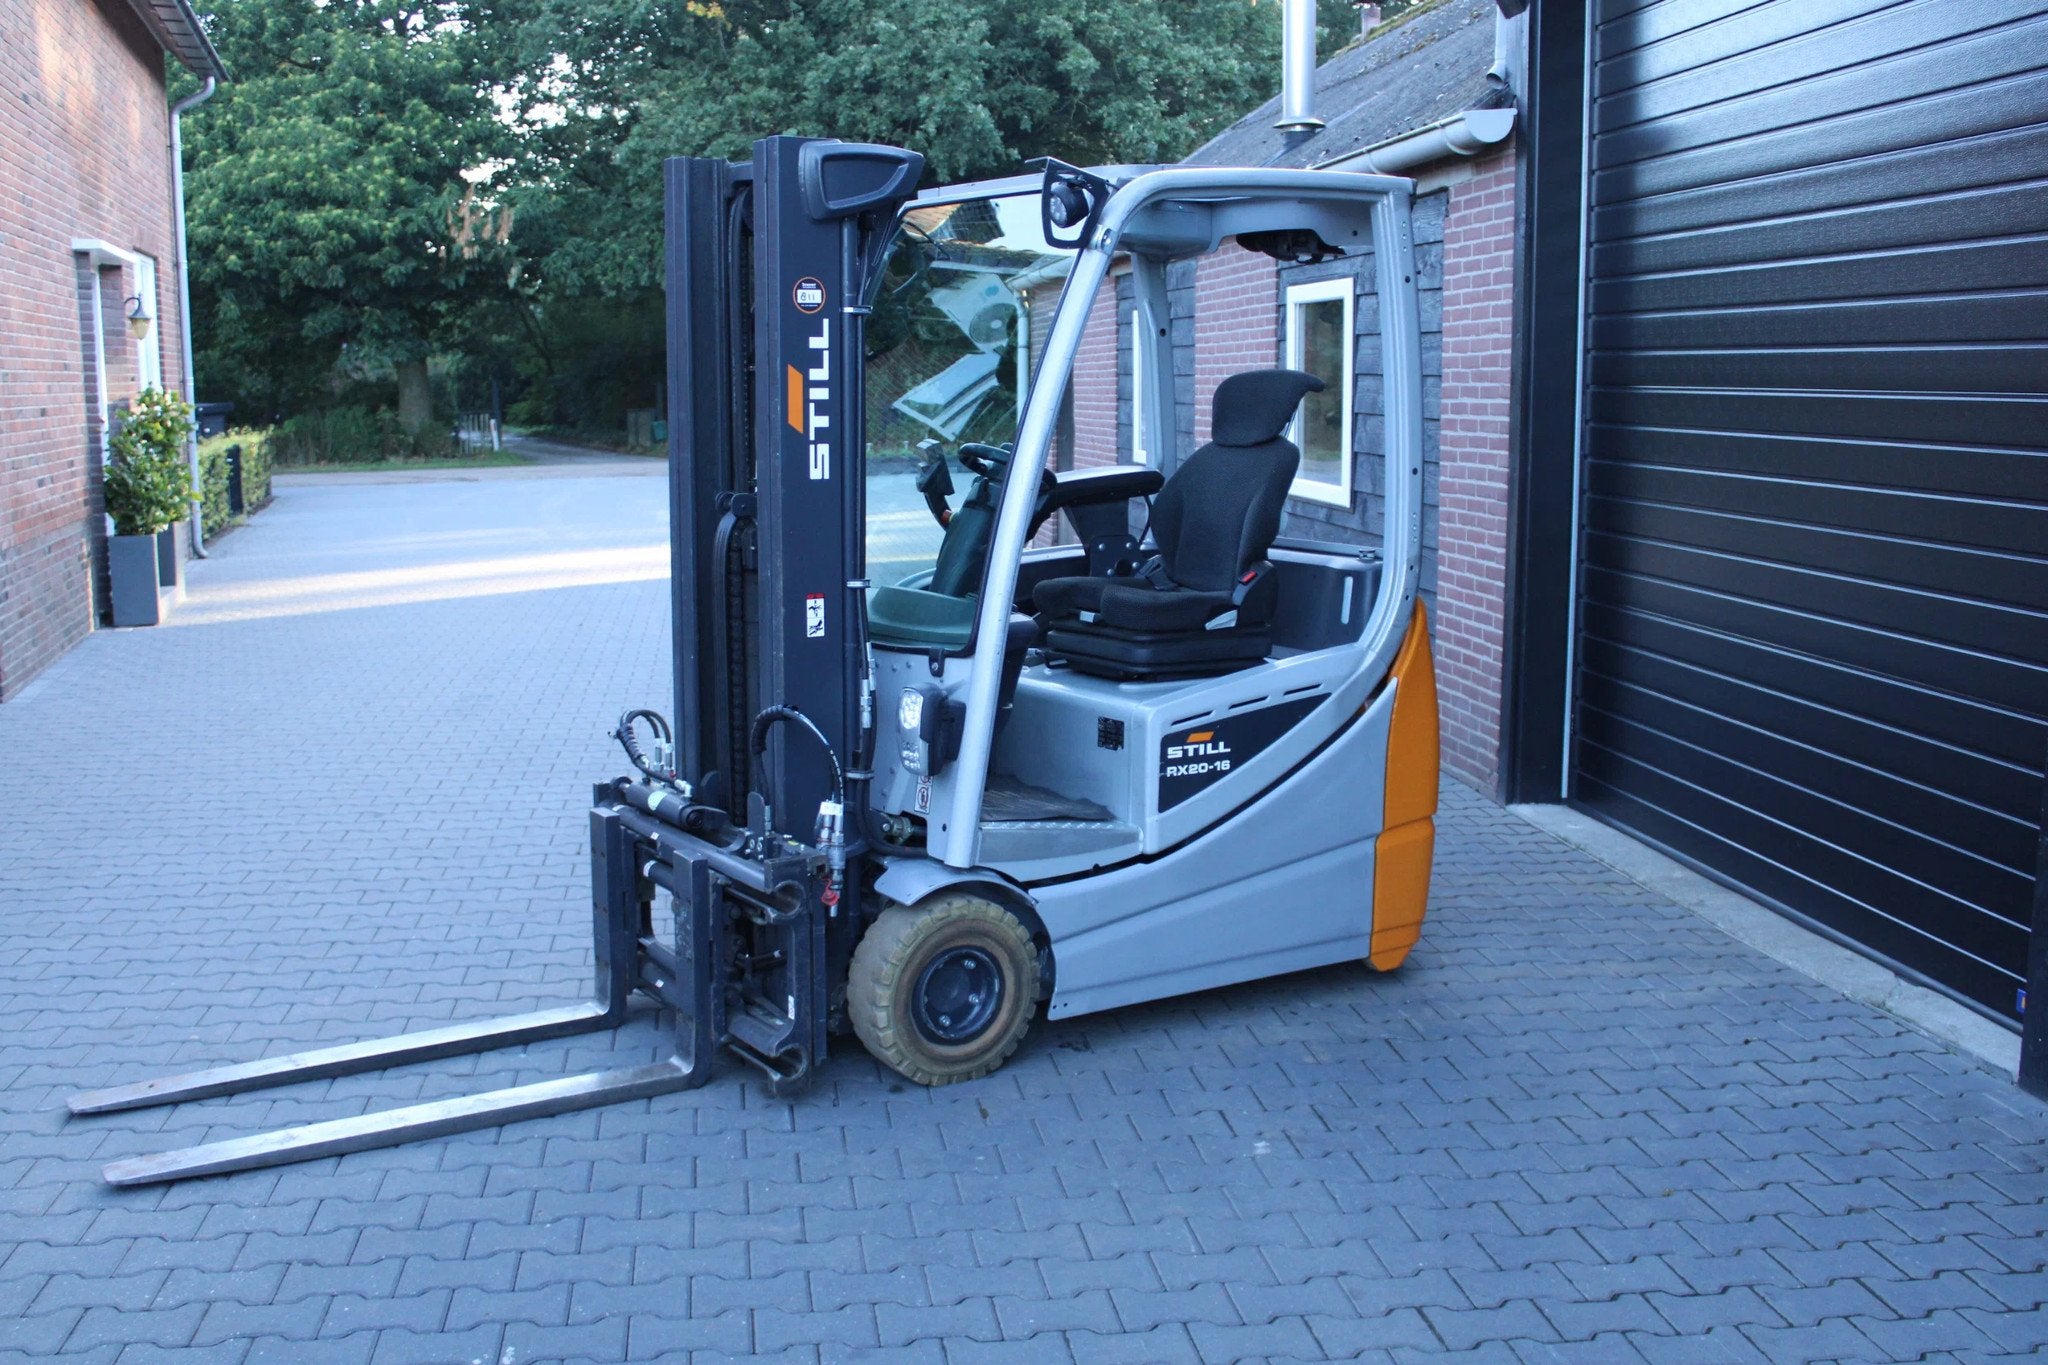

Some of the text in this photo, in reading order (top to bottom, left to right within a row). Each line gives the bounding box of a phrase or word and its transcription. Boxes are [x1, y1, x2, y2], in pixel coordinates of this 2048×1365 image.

[809, 318, 830, 480] STILL
[1167, 741, 1231, 759] STILL
[1166, 760, 1231, 777] RX20-16
